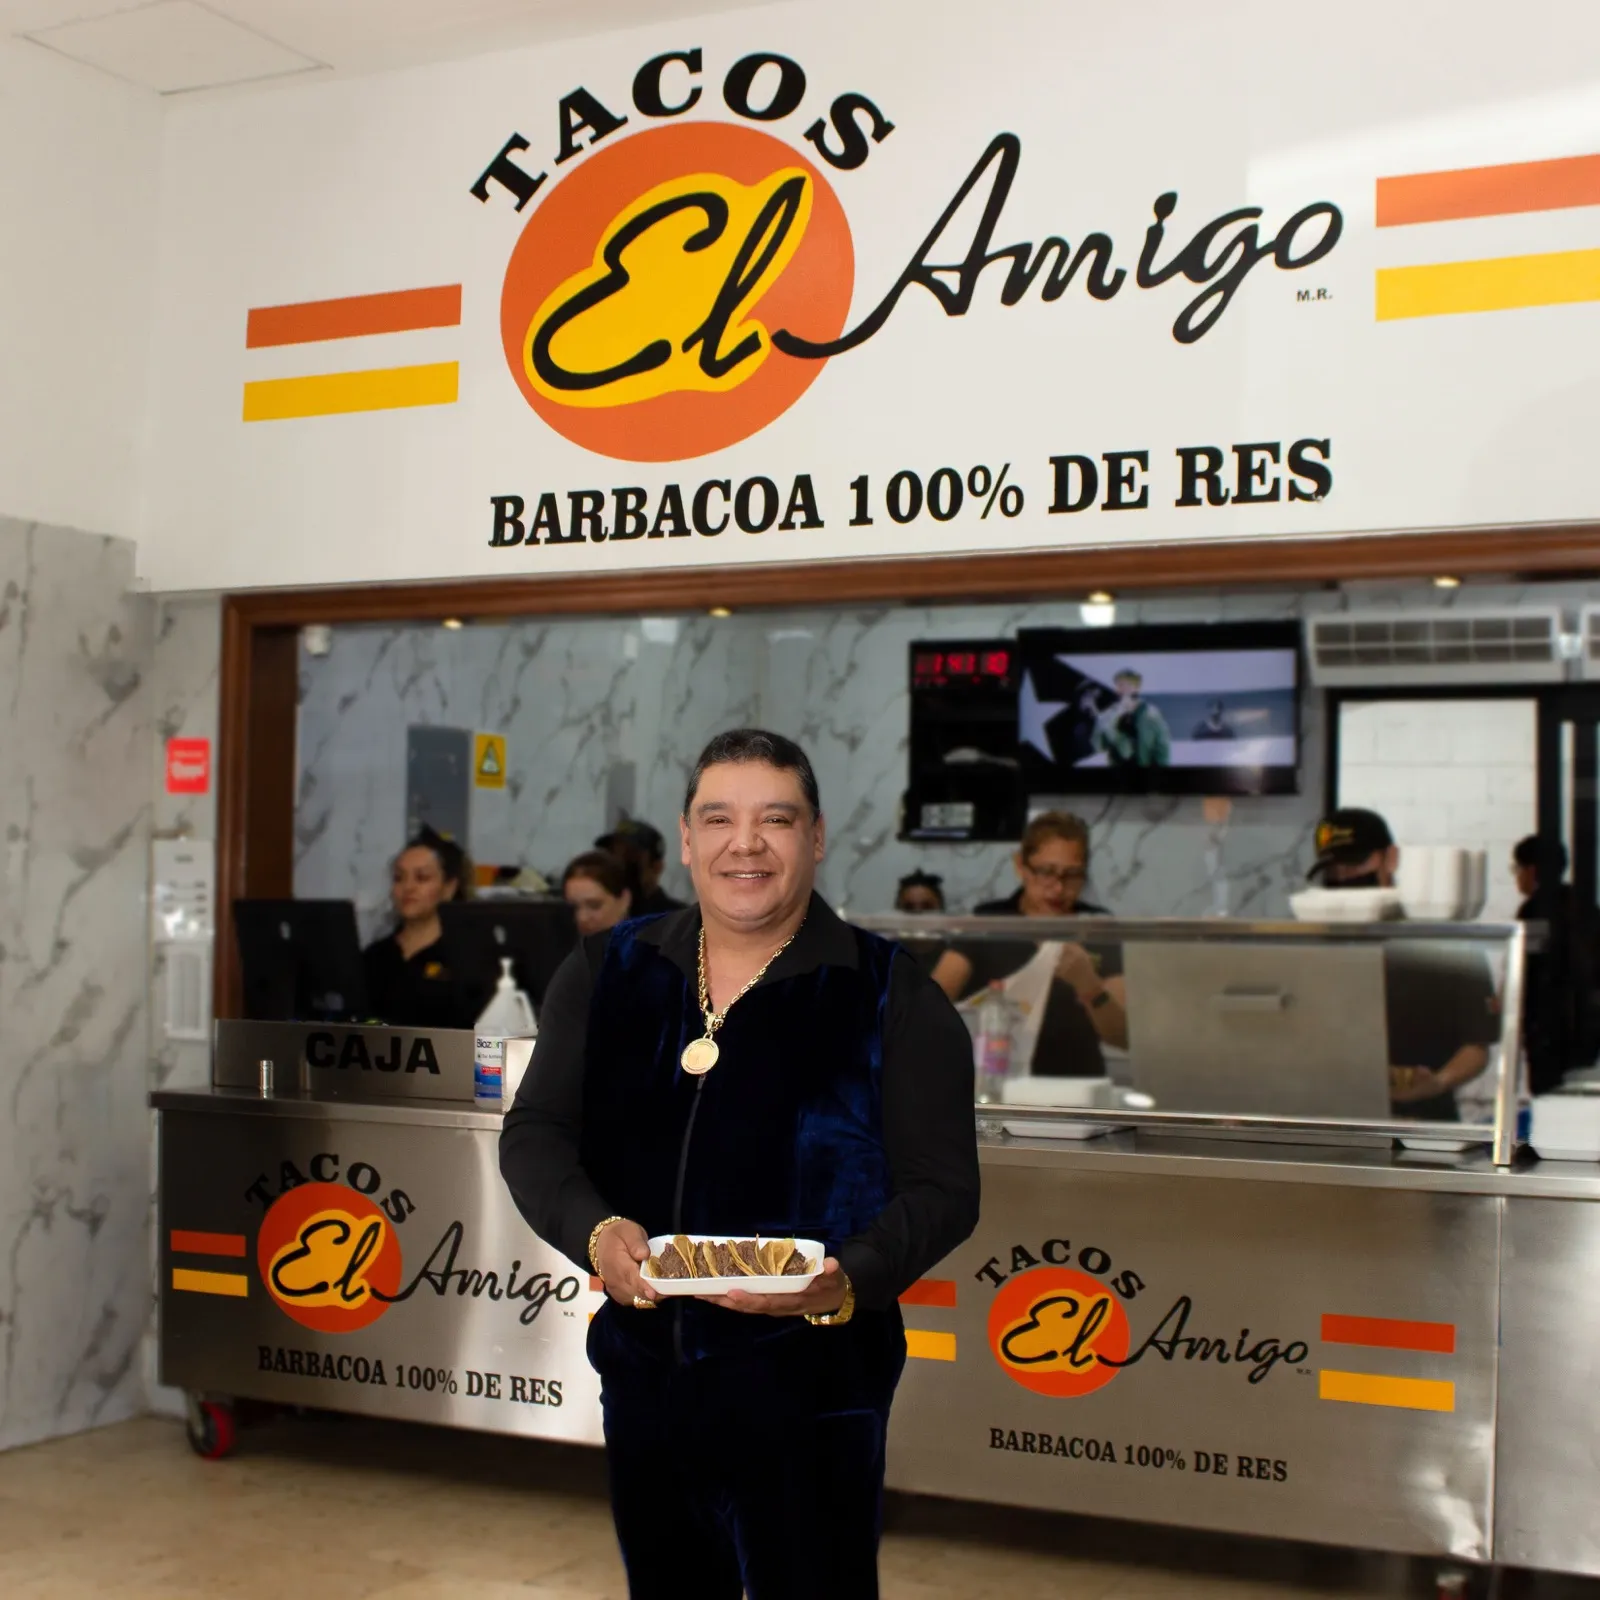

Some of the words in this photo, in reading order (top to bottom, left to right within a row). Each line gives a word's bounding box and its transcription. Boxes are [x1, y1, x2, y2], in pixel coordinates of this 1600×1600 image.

[469, 47, 896, 213] TACOS
[531, 175, 807, 391] El
[770, 131, 1344, 359] Amigo
[1296, 287, 1334, 303] M.R.
[488, 473, 825, 548] BARBACOA
[848, 462, 1025, 527] 100%
[1048, 450, 1150, 515] DE
[1175, 438, 1334, 508] RES
[306, 1032, 440, 1075] CAJA
[246, 1154, 416, 1224] TACOS
[271, 1219, 383, 1303] El
[370, 1220, 580, 1326] Amigo
[974, 1239, 1146, 1300] TACOS
[1001, 1295, 1110, 1368] El
[1096, 1295, 1309, 1385] Amigo
[257, 1345, 387, 1387] BARBACOA
[395, 1365, 458, 1396] 100%
[466, 1370, 502, 1400] DE
[509, 1375, 564, 1408] RES
[988, 1427, 1118, 1464] BARBACOA
[1123, 1444, 1187, 1472] 100%
[1193, 1451, 1229, 1477] DE
[1236, 1456, 1288, 1483] RES
